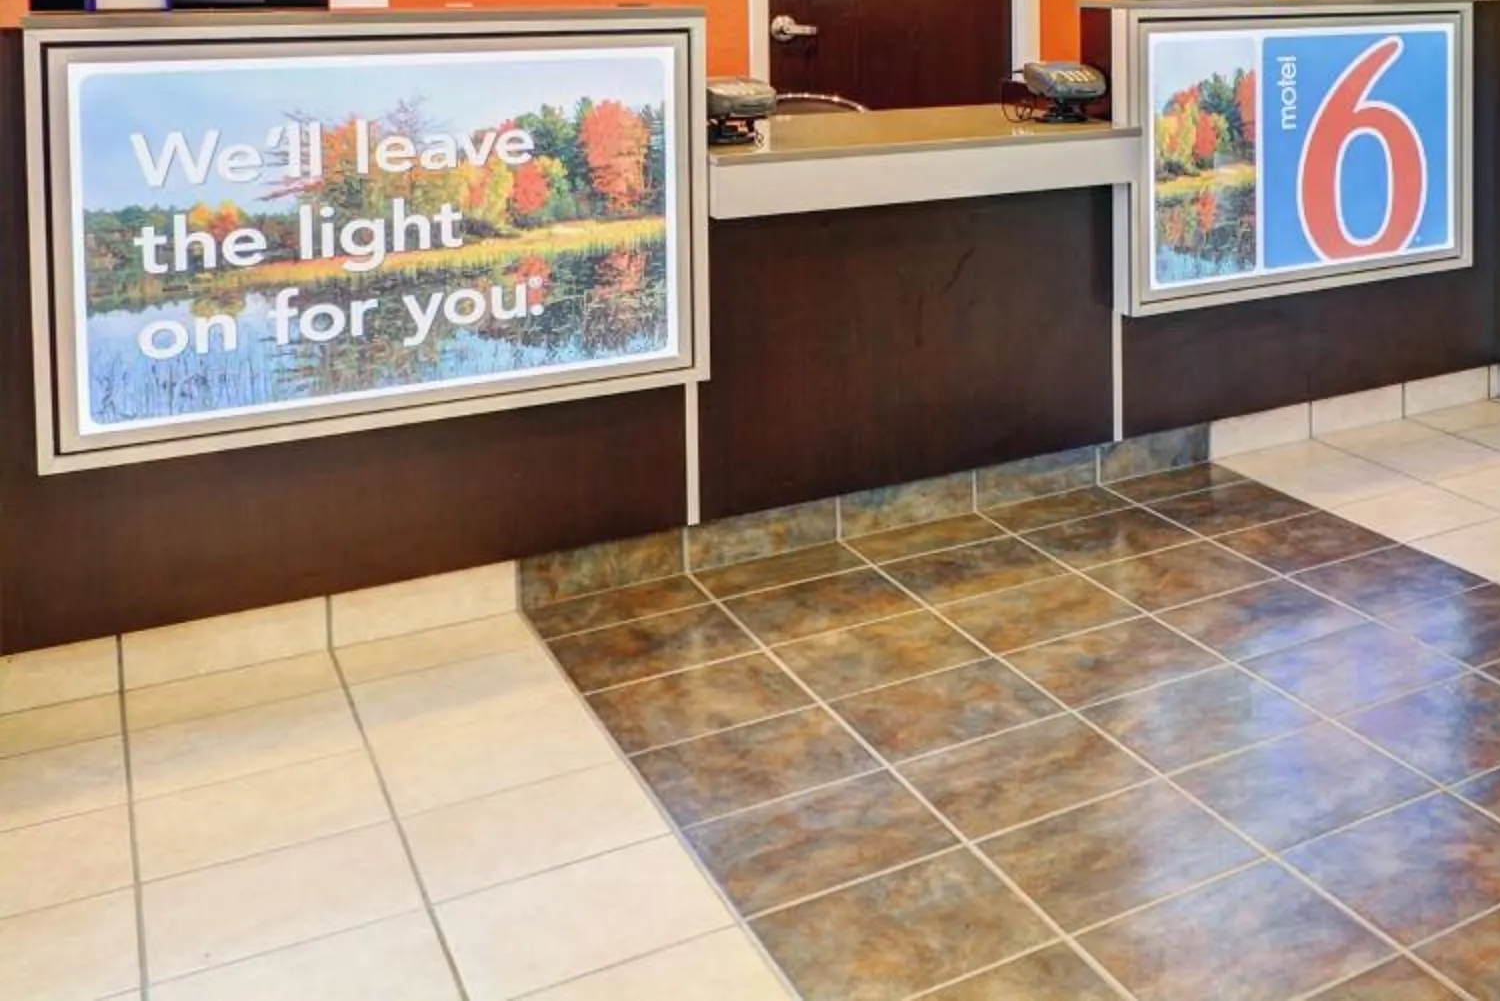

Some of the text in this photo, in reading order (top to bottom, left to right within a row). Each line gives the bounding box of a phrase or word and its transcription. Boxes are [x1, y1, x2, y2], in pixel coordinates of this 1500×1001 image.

[1276, 55, 1297, 130] motel
[130, 119, 535, 187] We'll leave
[1296, 35, 1428, 264] 6
[134, 198, 463, 274] the light
[138, 313, 238, 359] on
[268, 288, 378, 345] for
